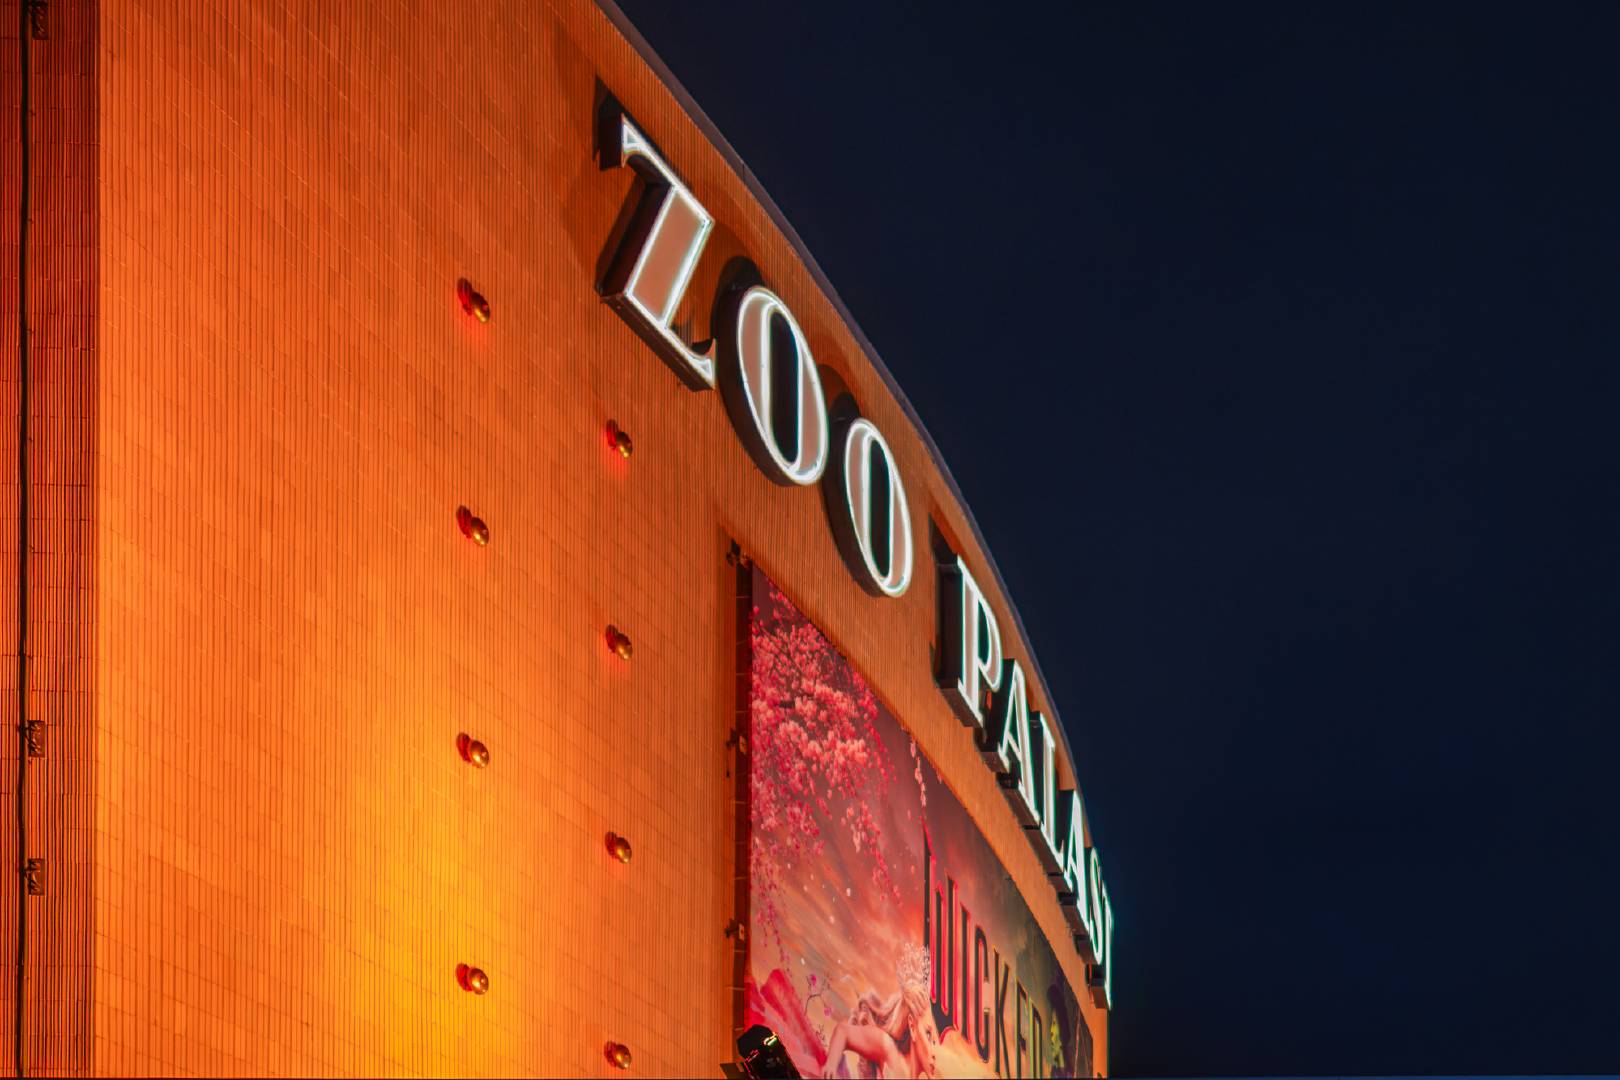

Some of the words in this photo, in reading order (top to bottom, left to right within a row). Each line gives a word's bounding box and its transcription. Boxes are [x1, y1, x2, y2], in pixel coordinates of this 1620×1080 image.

[620, 112, 914, 599] ZOO
[956, 553, 1115, 1011] PALAST
[922, 820, 1044, 1079] WICKED
